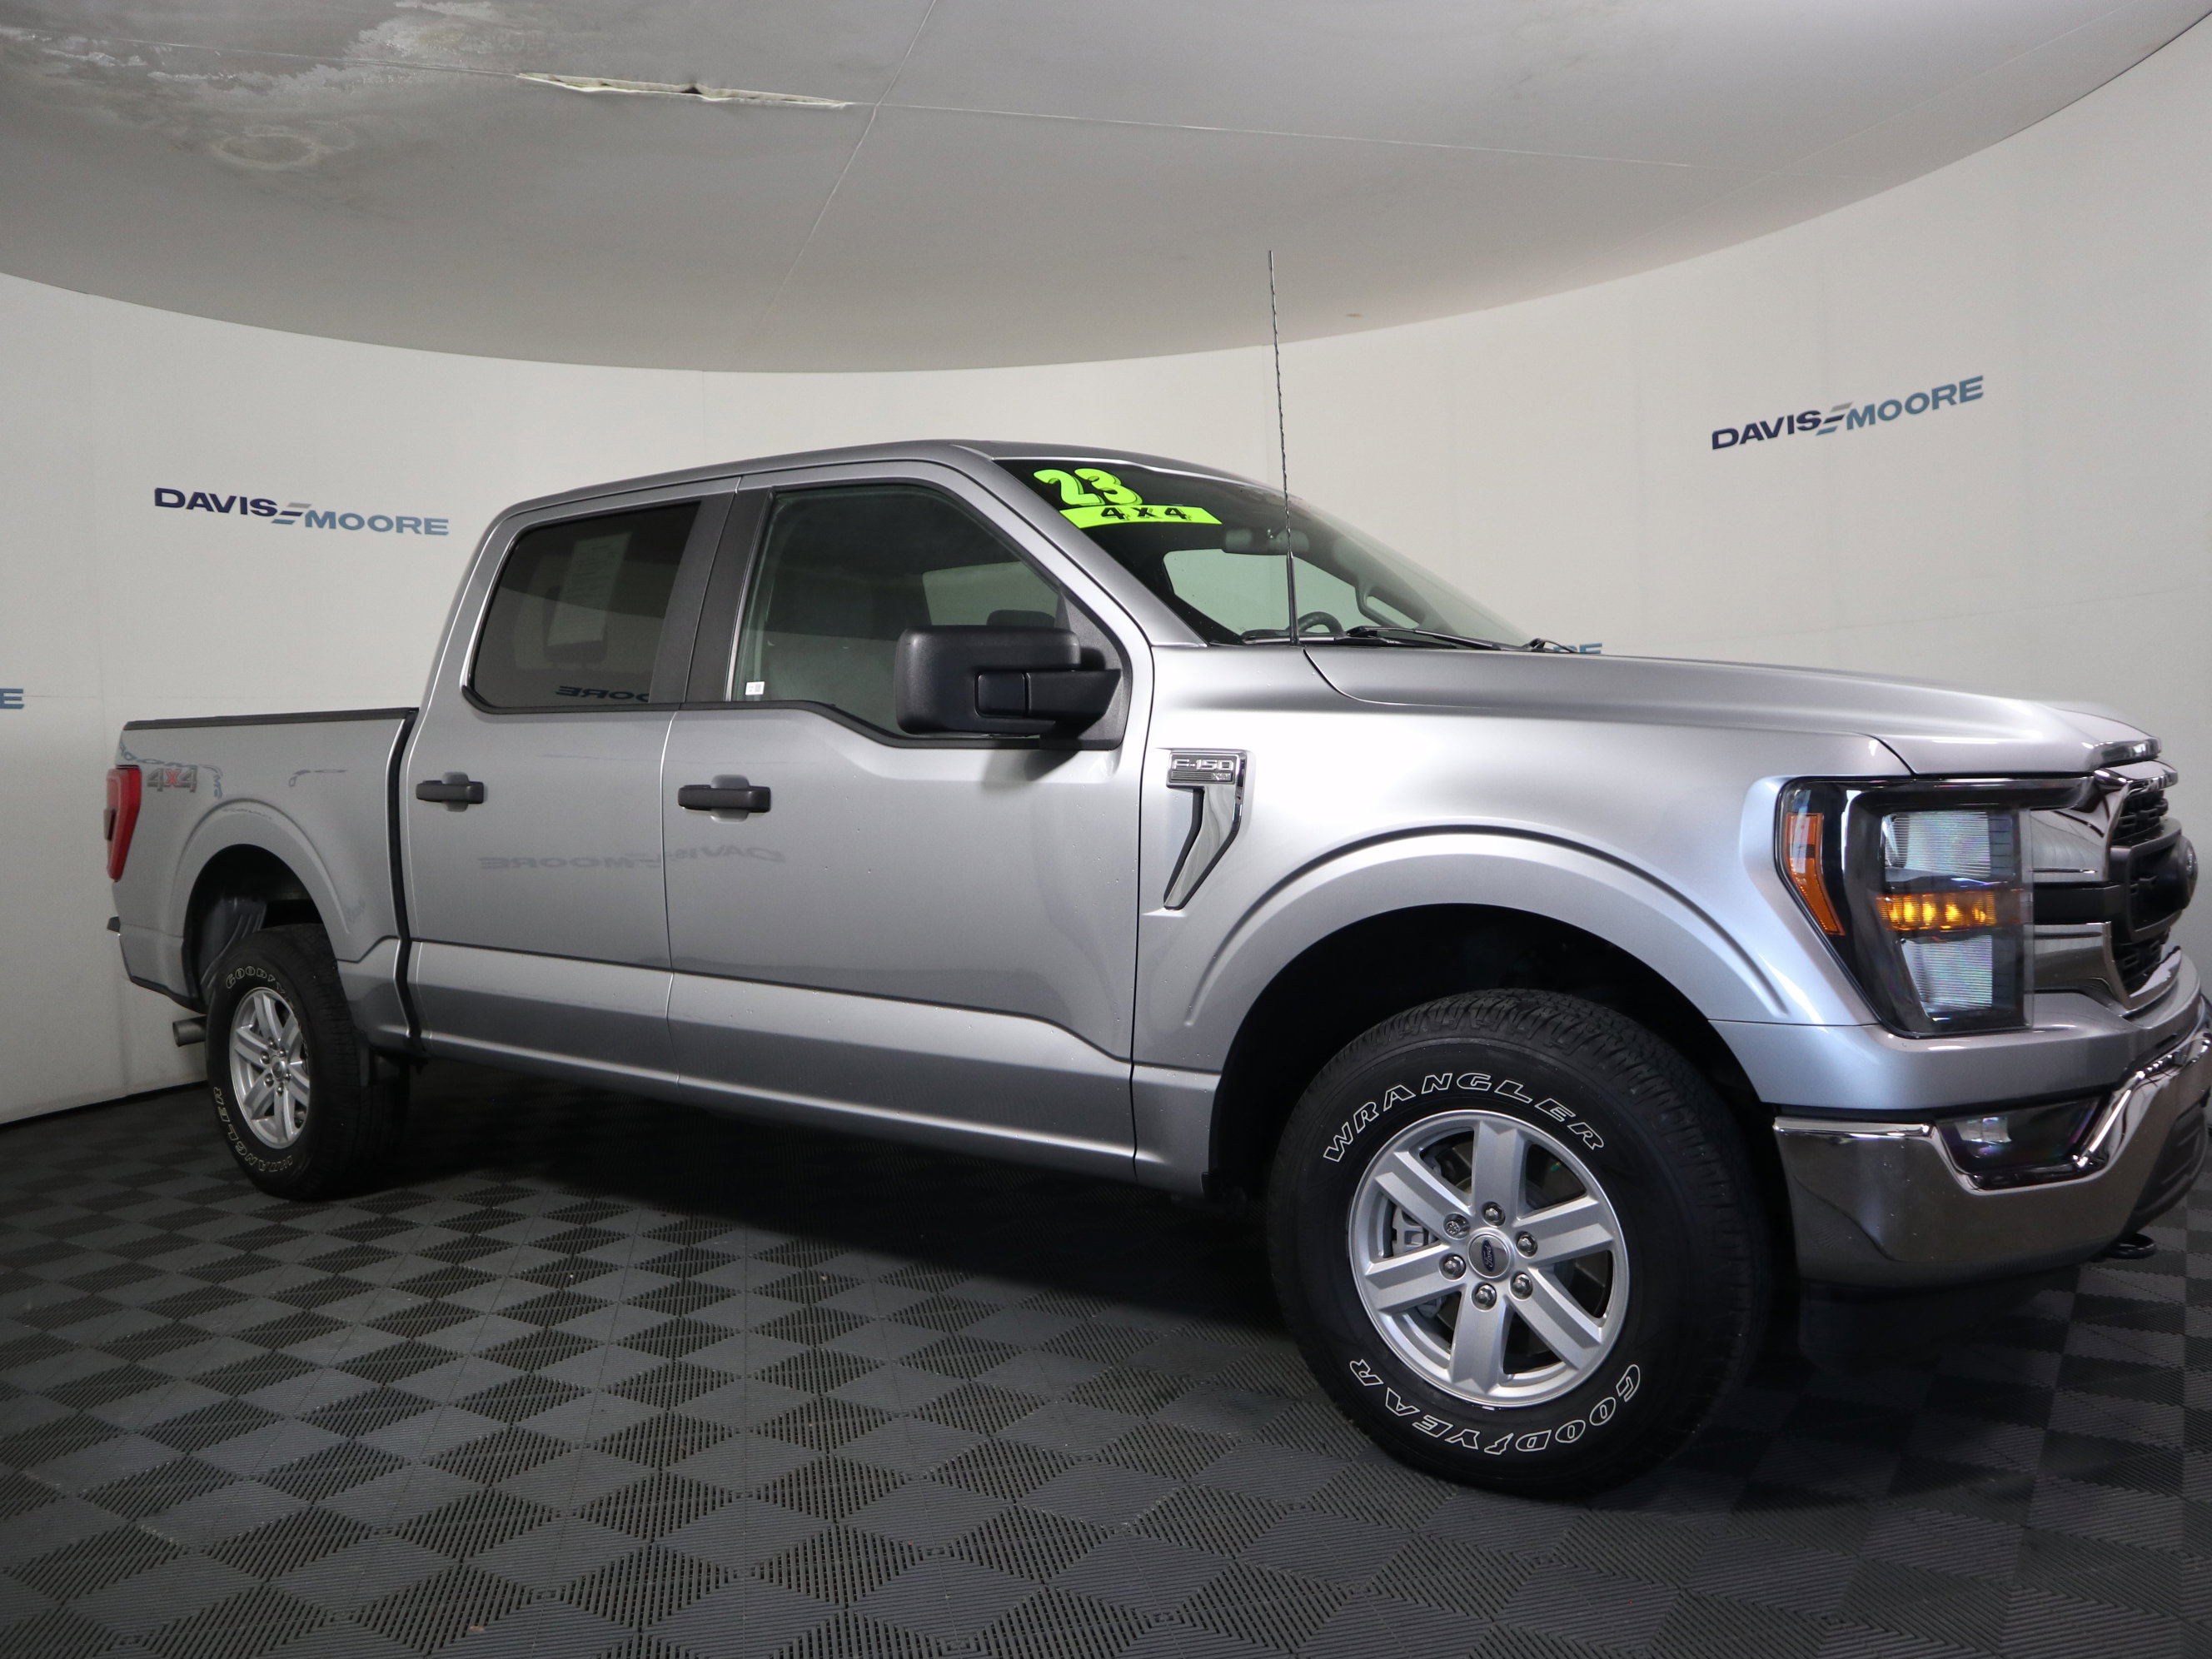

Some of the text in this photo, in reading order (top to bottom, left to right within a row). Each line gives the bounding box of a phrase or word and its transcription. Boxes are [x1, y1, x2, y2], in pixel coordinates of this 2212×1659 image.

[1711, 375, 1984, 451] DAVIS MOORE
[154, 487, 450, 536] DAVIS MOORE
[1033, 468, 1143, 506] 23
[1171, 758, 1233, 771] F-150
[1323, 1072, 1605, 1163] WRANGLER
[1349, 1358, 1641, 1455] GOODYEAR
